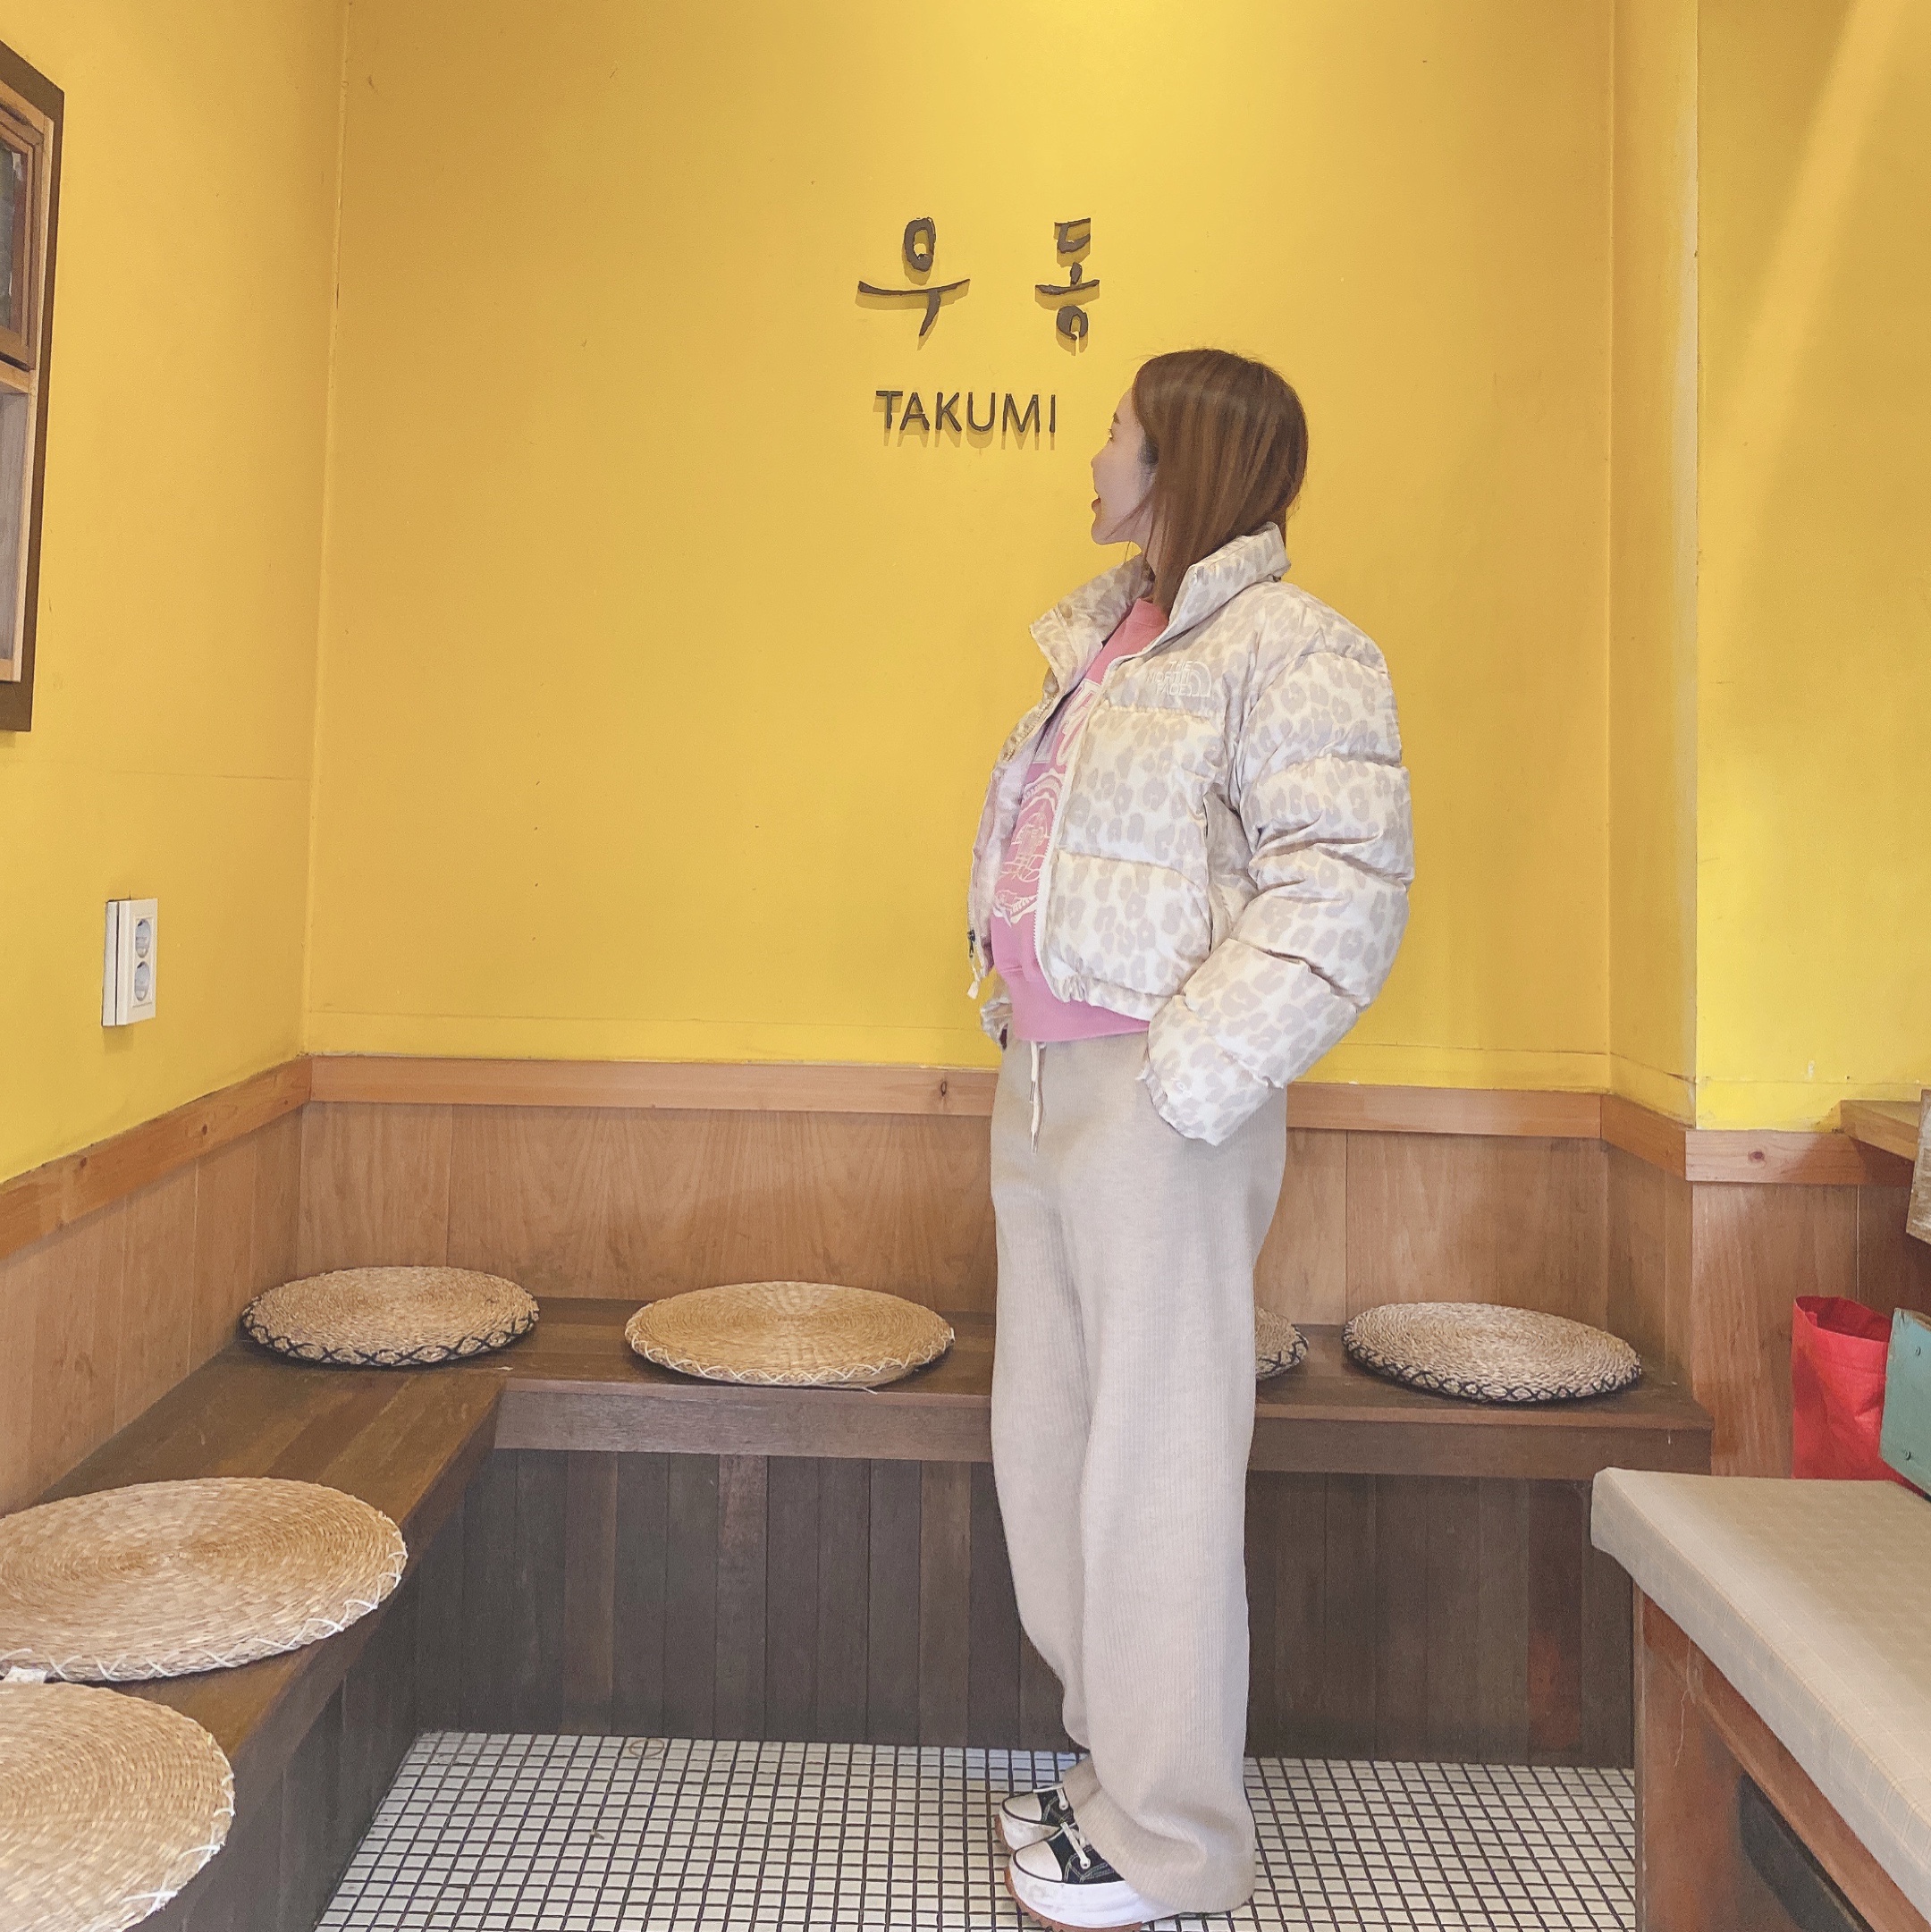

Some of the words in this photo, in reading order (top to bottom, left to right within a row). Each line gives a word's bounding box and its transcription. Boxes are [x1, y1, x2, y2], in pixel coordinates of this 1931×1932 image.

[857, 216, 1100, 341] 우동
[875, 390, 1056, 434] TAKUMI
[1168, 660, 1193, 672] THE
[1145, 671, 1190, 685] NORTH
[1155, 683, 1188, 696] FACE
